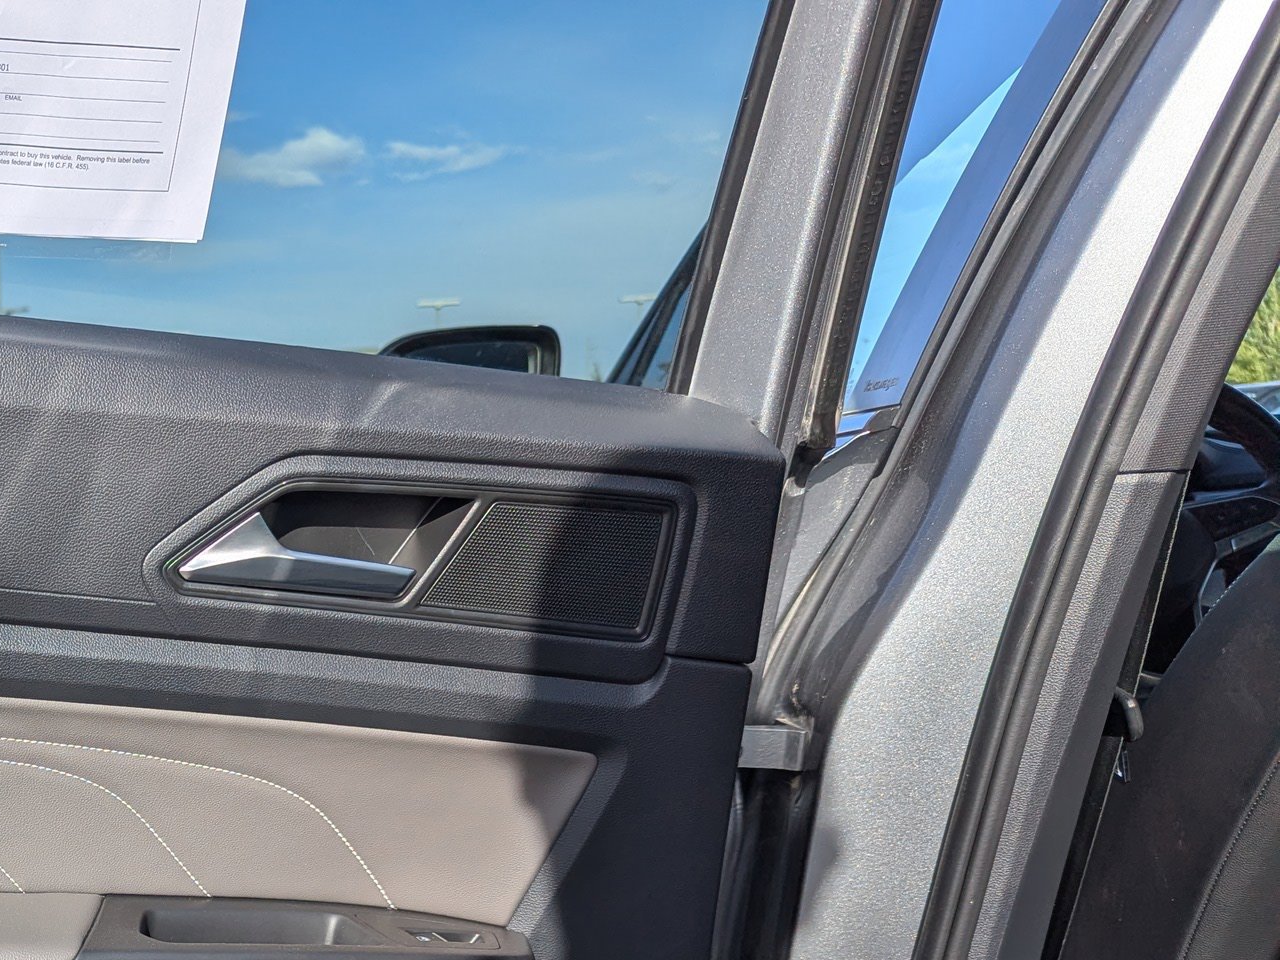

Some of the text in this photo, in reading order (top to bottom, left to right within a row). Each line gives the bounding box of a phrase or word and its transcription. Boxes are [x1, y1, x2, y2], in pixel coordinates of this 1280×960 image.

[4, 94, 22, 102] EMAIL
[11, 158, 31, 167] federal
[32, 159, 44, 168] law
[27, 151, 38, 160] buy
[51, 153, 72, 161] vehicle.
[76, 154, 105, 164] Removing
[106, 155, 117, 163] this
[117, 156, 132, 164] label
[132, 157, 150, 165] before
